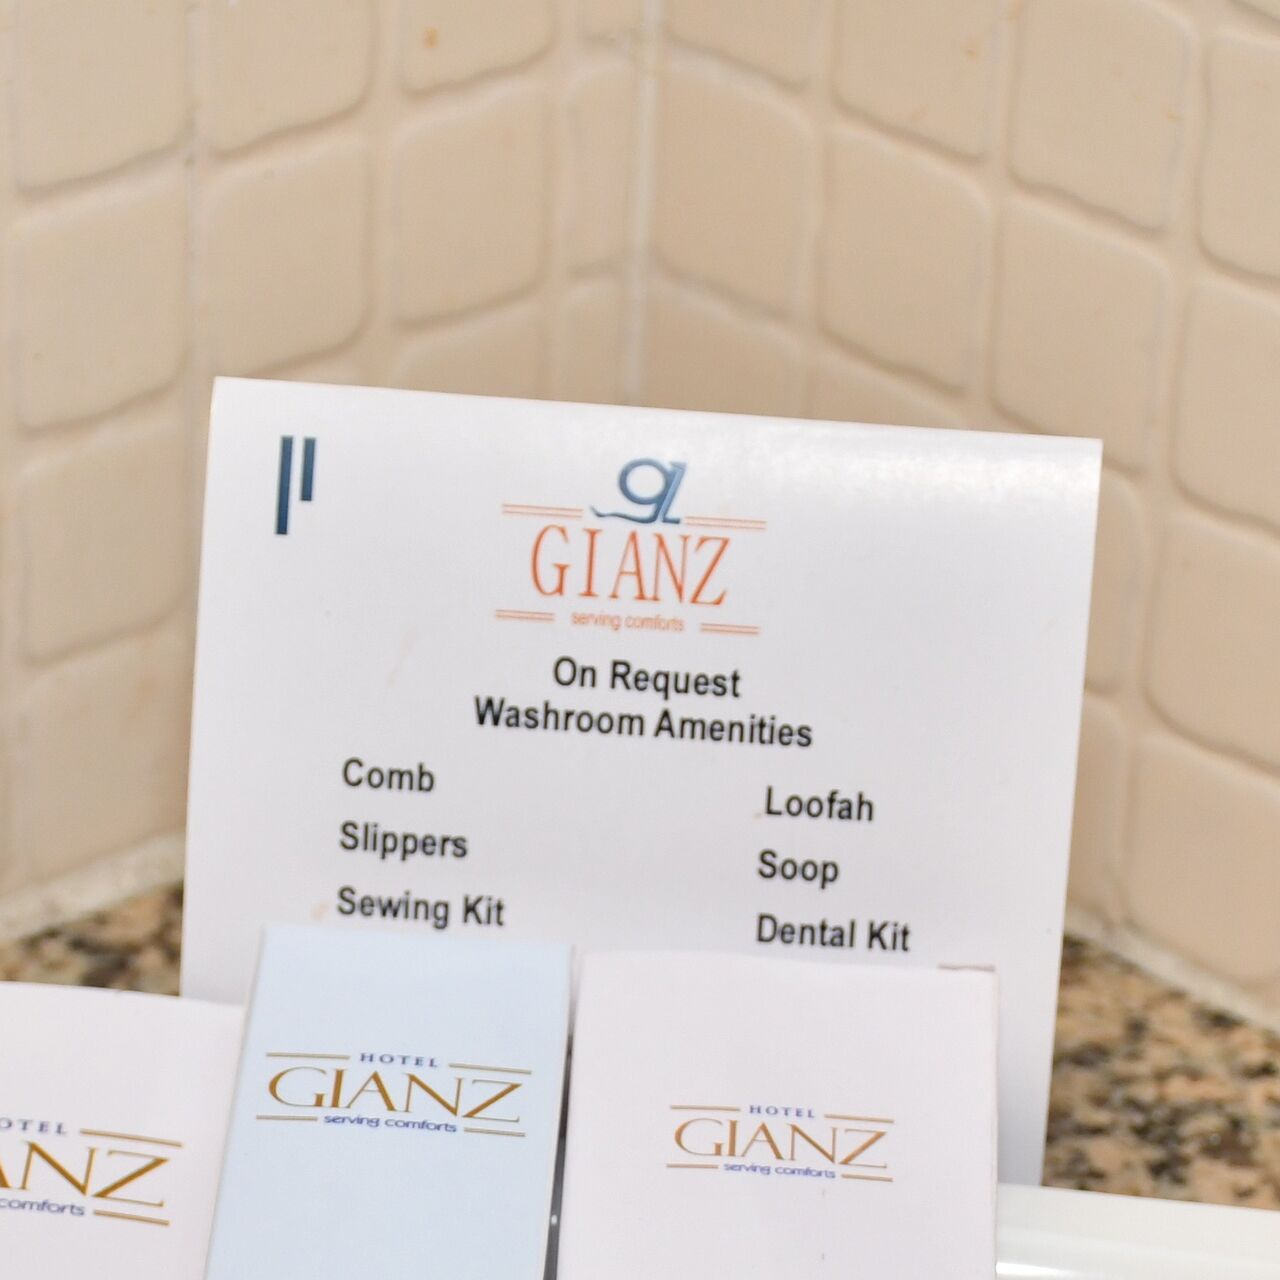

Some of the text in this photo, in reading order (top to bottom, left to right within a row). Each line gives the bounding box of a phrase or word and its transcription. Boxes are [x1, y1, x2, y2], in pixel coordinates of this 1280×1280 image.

[532, 524, 730, 606] GIANZ
[572, 611, 685, 632] serving comforts
[554, 656, 741, 700] On Request
[474, 695, 813, 747] Washroom Amenities
[342, 757, 435, 792] Comb
[765, 785, 874, 822] Loofah
[340, 821, 468, 861] Slippers
[758, 849, 839, 890] Soop
[337, 886, 505, 930] Sewing Kit
[756, 913, 910, 952] Dental Kit
[360, 1051, 439, 1068] HOTEL
[268, 1066, 522, 1124] GIANZ
[749, 1104, 816, 1118] HOTEL
[323, 1113, 457, 1134] serving comforts
[674, 1118, 887, 1169] GIANZ
[724, 1162, 836, 1179] serving comforts
